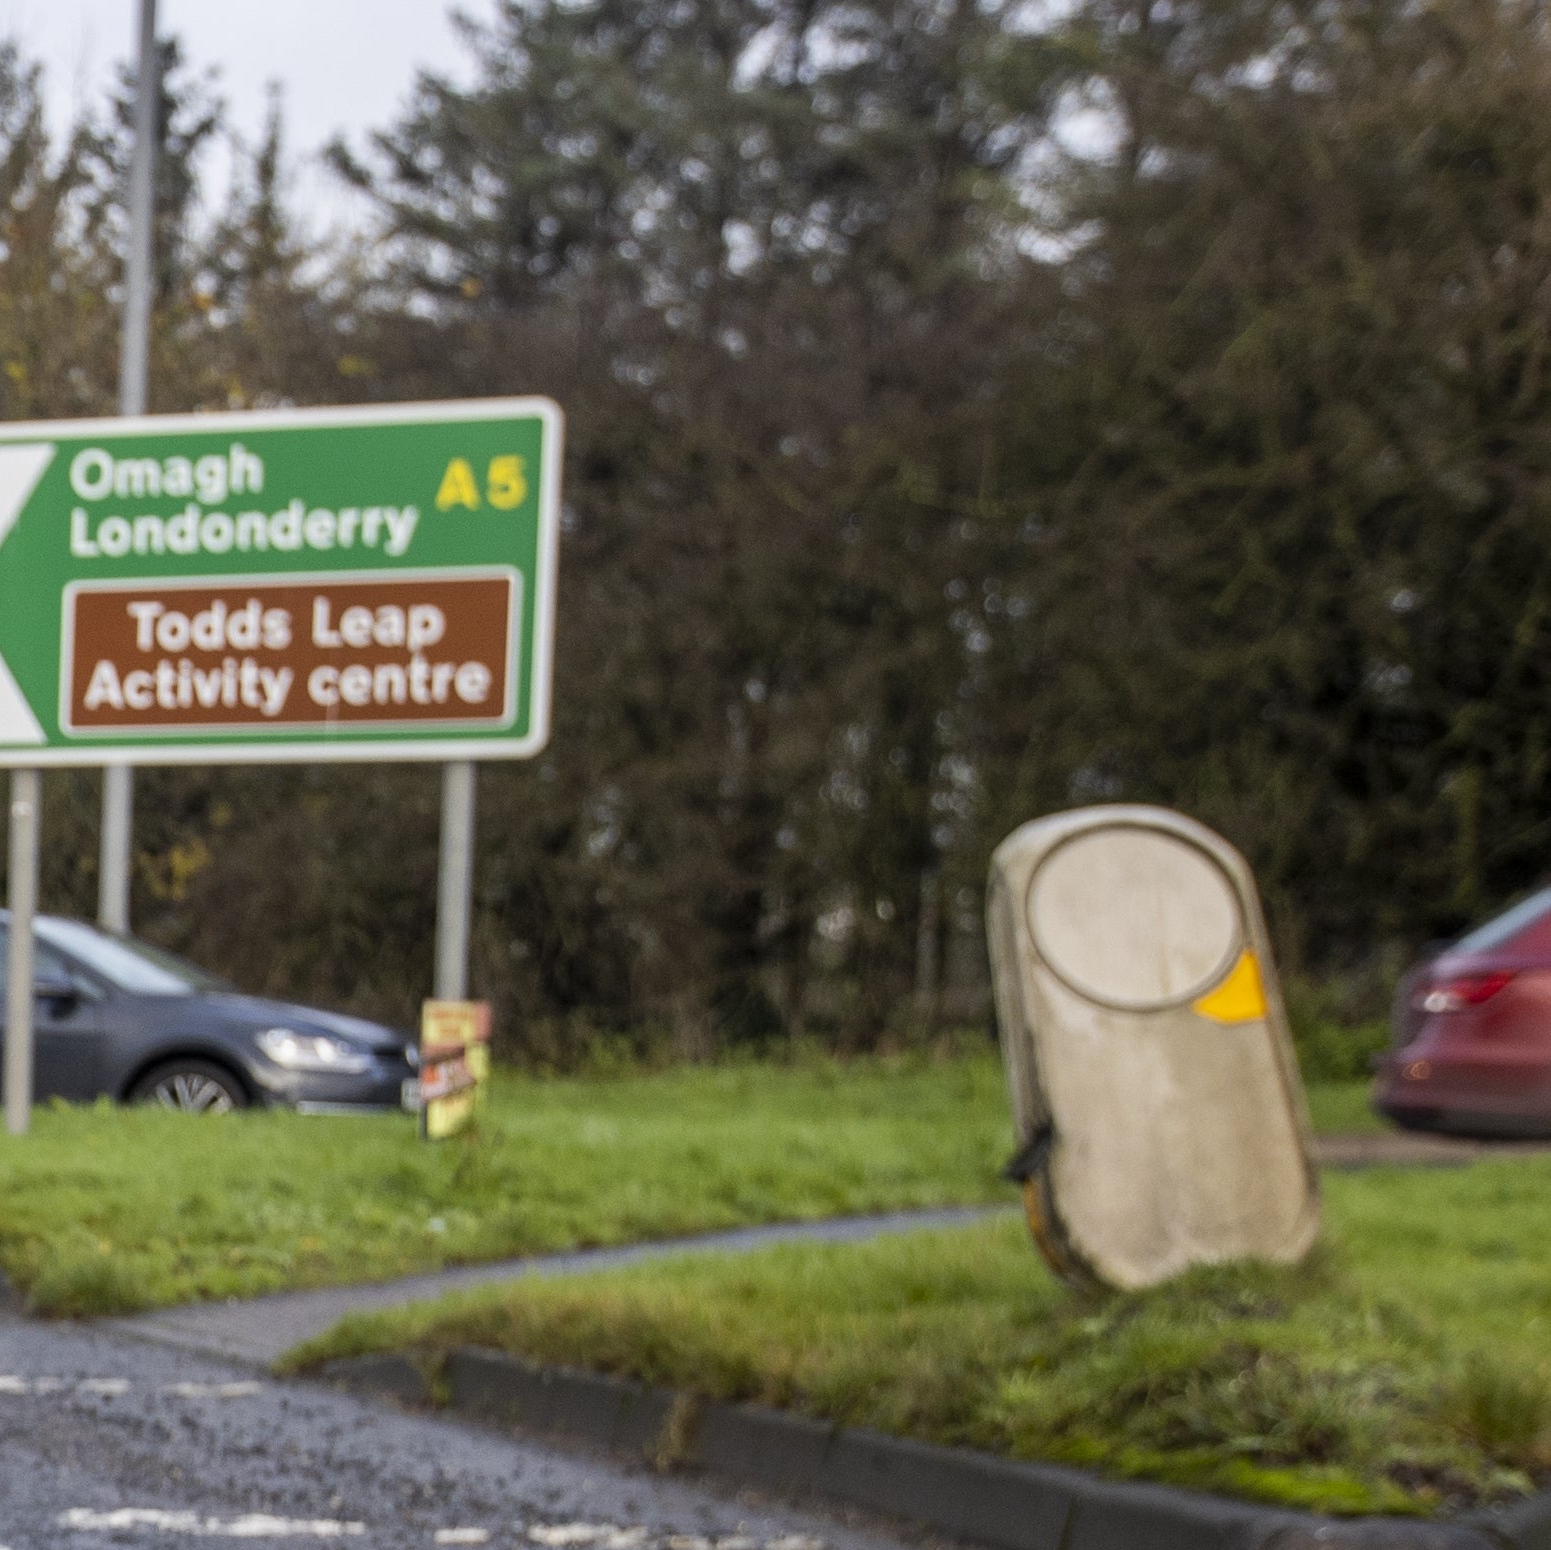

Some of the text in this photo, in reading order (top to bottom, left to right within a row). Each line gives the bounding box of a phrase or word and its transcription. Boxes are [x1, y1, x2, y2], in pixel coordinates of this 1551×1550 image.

[70, 443, 263, 504] Omagh
[436, 454, 528, 511] A5
[70, 500, 419, 557] Londonderry
[128, 597, 446, 656] Todds Leap
[84, 657, 493, 716] Activity centre
